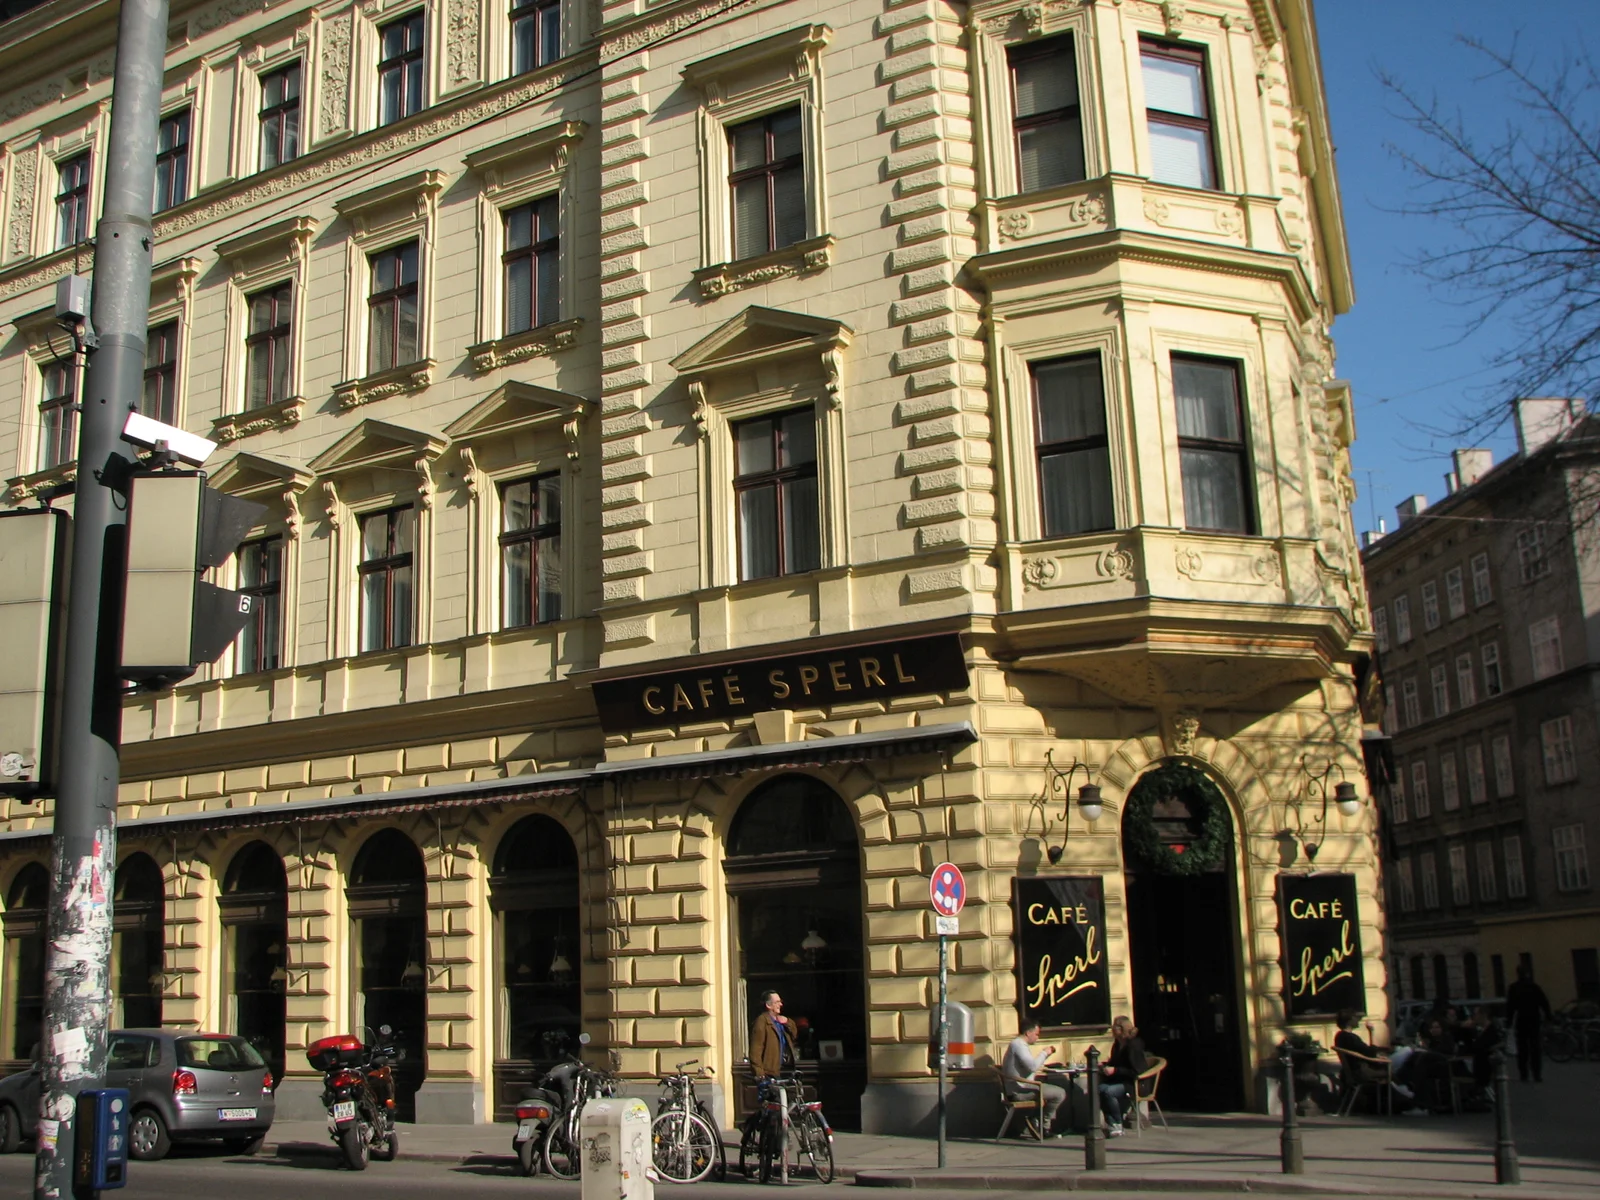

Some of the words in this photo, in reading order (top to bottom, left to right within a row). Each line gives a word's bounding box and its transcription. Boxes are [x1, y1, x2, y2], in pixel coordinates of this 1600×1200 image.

[241, 596, 251, 612] 6
[642, 668, 745, 715] CAFÉ
[768, 653, 916, 699] SPERL
[1027, 903, 1089, 925] CAFÉ
[1290, 898, 1343, 919] CAFÉ
[1026, 925, 1101, 1008] Sperl
[1290, 919, 1355, 997] Sperl
